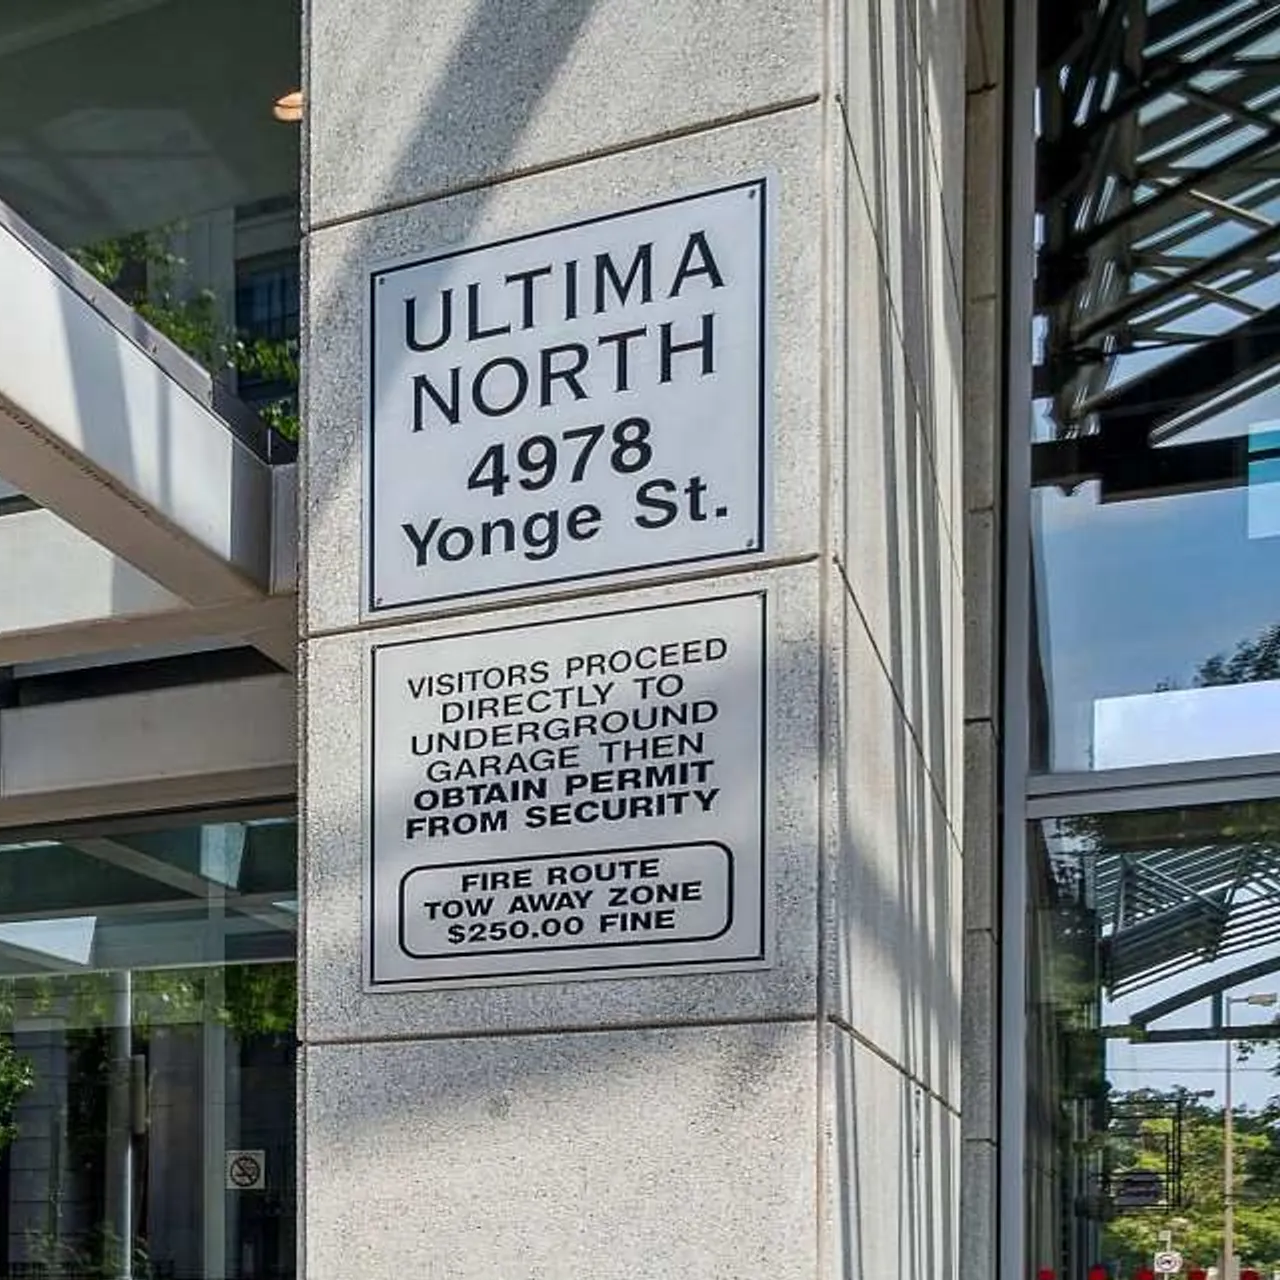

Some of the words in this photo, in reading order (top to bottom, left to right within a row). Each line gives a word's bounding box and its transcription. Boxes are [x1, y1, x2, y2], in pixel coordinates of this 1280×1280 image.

[403, 230, 726, 353] ULTIMA
[412, 313, 715, 433] NORTH
[467, 417, 653, 497] 4978
[401, 504, 602, 567] Yonge
[634, 476, 728, 529] St.
[407, 660, 549, 699] VISITORS
[566, 637, 728, 679] PROCEED
[442, 681, 615, 724] DIRECTLY
[633, 673, 684, 700] TO
[411, 699, 719, 756] UNDERGROUND
[426, 744, 580, 784] GARAGE
[598, 731, 704, 764] THEN
[413, 777, 547, 812] OBTAIN
[565, 759, 715, 797] PERMIT
[405, 809, 508, 840] FROM
[524, 787, 721, 829] SECURITY
[423, 897, 495, 921] TOW
[507, 889, 594, 915] AWAY
[608, 880, 703, 907] ZONE
[461, 868, 533, 894] FIRE
[547, 857, 660, 886] ROUTE
[447, 916, 585, 945] $250.00
[599, 908, 676, 934] FINE
